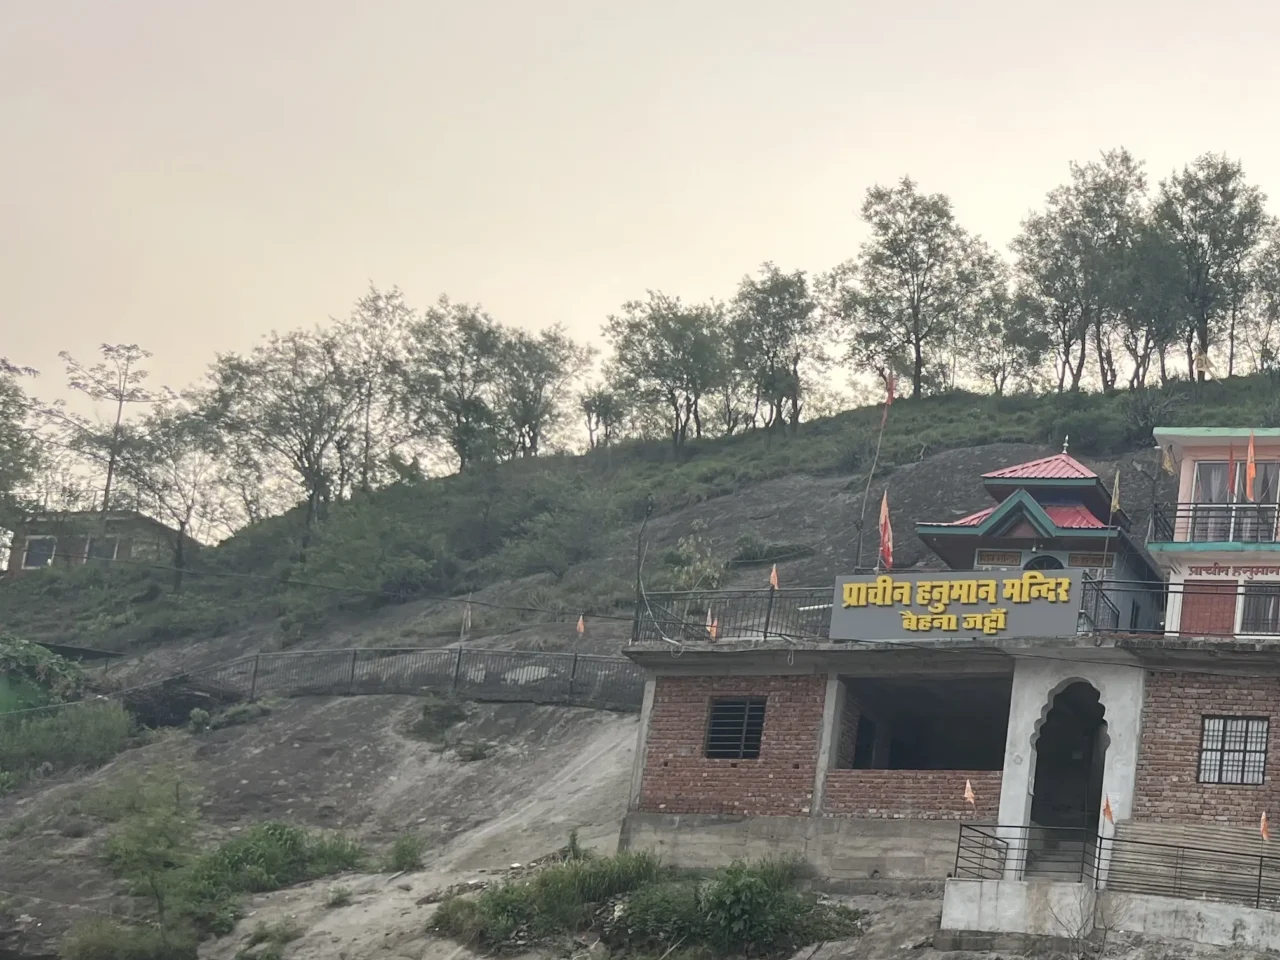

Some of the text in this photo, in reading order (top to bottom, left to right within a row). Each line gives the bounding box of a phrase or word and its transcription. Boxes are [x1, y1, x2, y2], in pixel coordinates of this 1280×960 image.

[1188, 562, 1230, 577] प्राचीन
[1232, 566, 1280, 580] हनुमान
[842, 571, 1071, 614] प्राचीन हनुमान मन्दिर
[899, 610, 959, 631] बैहना
